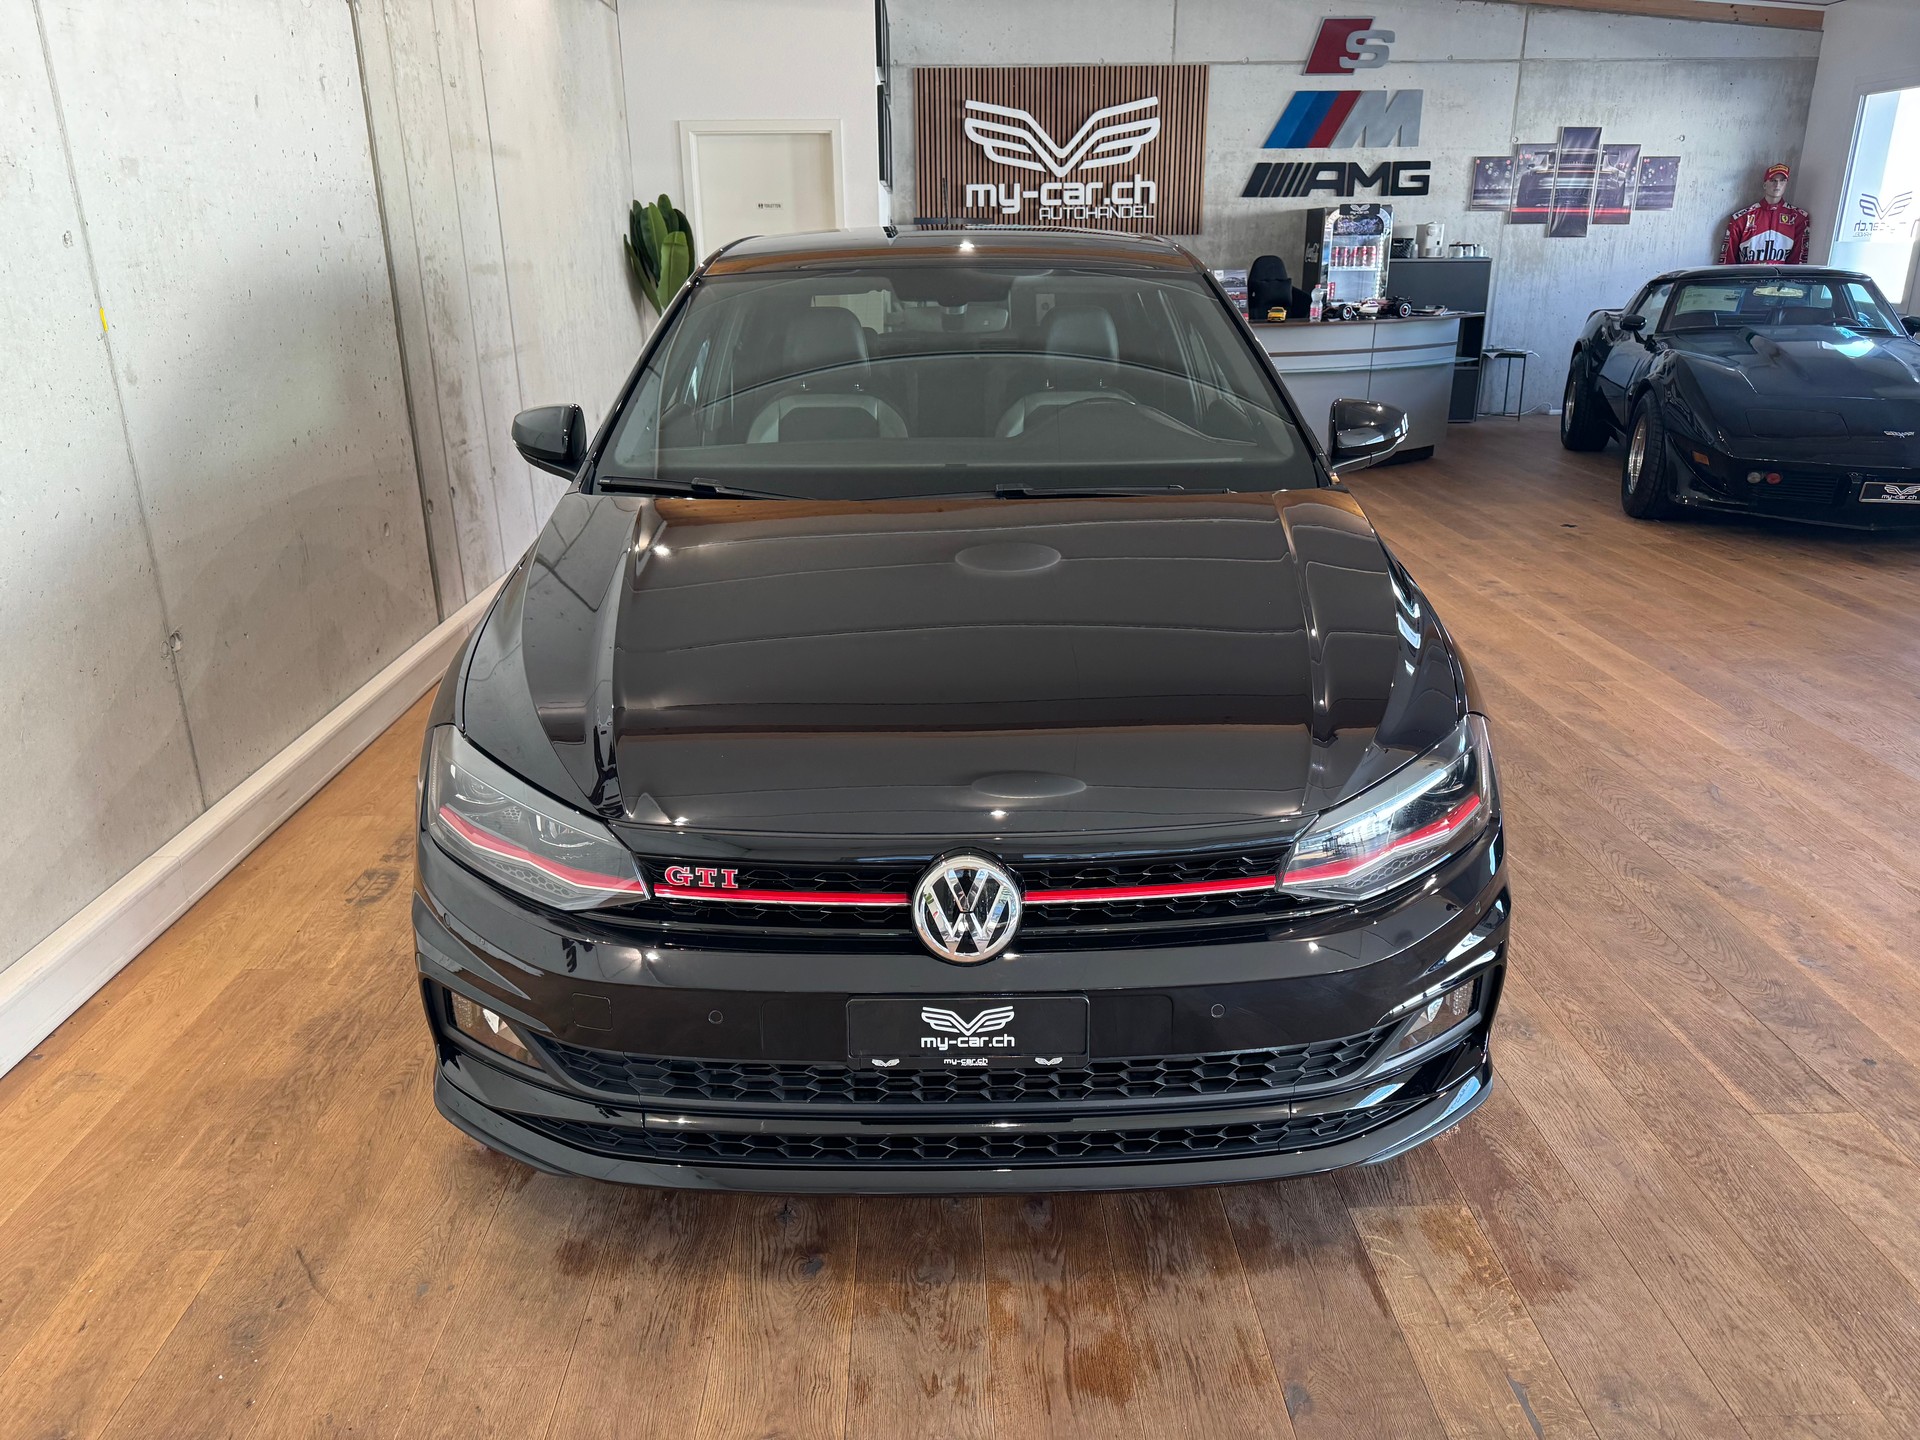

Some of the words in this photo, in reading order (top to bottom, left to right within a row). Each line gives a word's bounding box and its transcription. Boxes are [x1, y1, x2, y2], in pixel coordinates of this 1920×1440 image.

[1299, 160, 1432, 197] AMG
[965, 173, 1157, 214] my-car.ch
[1039, 204, 1156, 221] AUTOHANDEL
[1881, 493, 1918, 501] my-car.ch
[664, 865, 739, 889] GTI
[920, 1033, 1016, 1051] my-car.ch
[943, 1057, 989, 1066] my-car.ch
